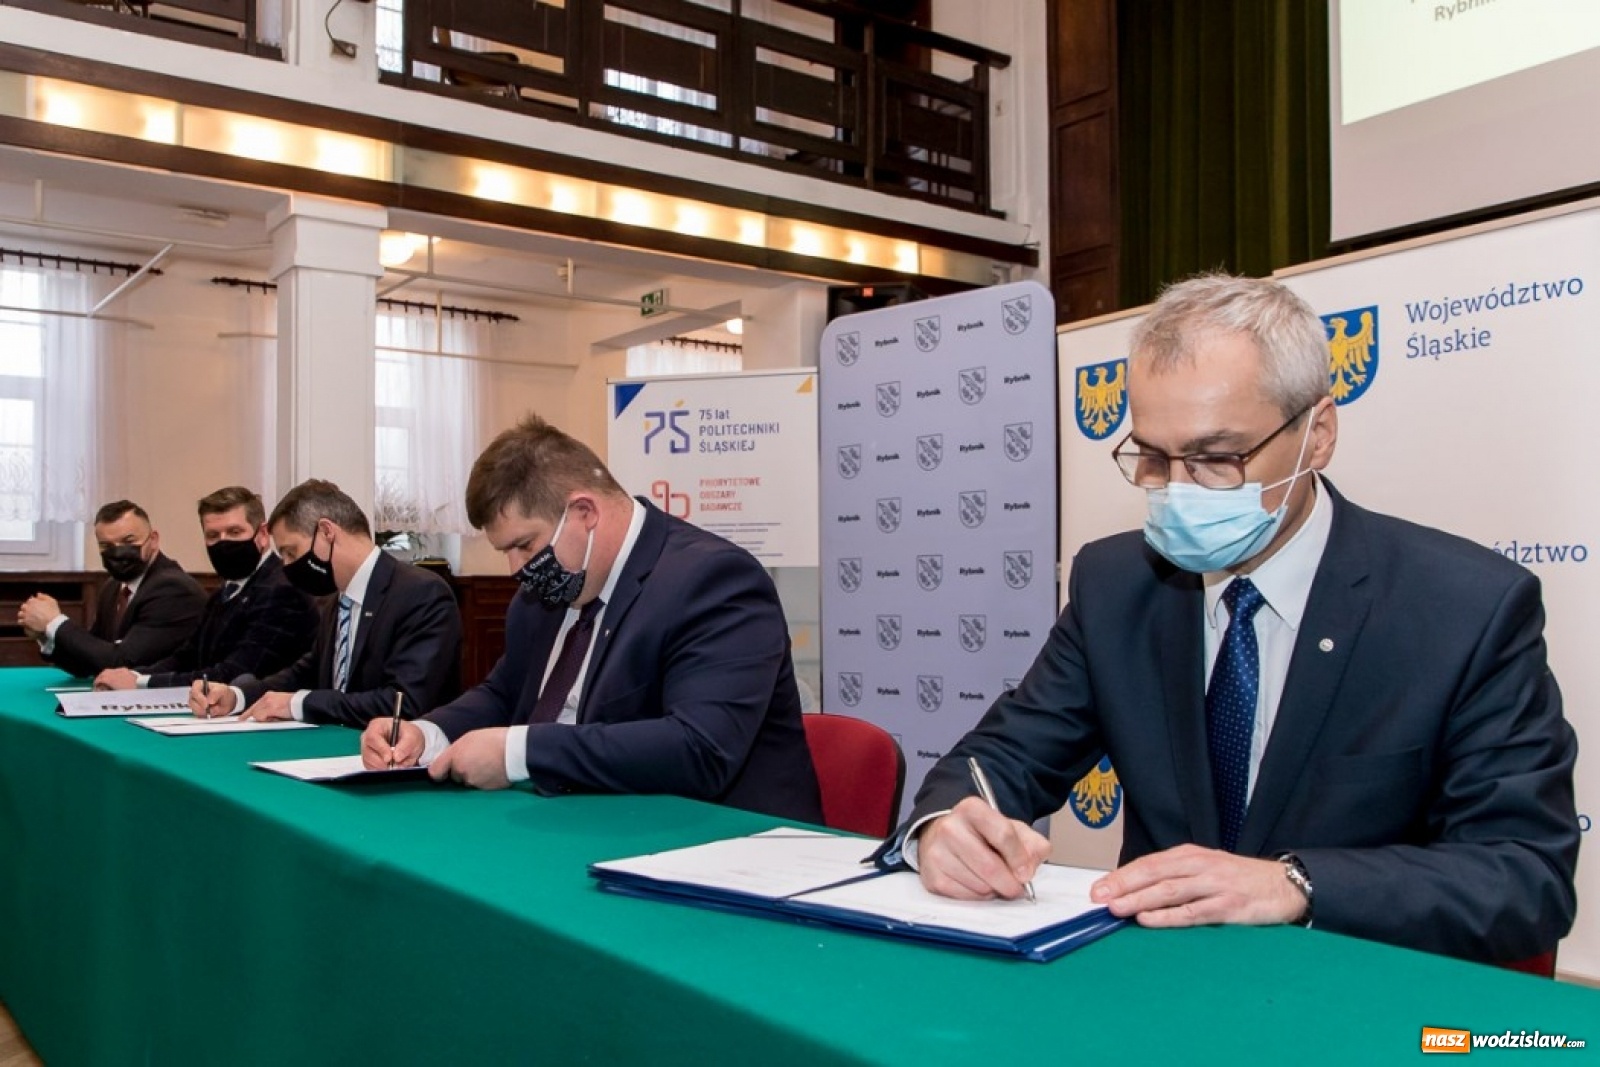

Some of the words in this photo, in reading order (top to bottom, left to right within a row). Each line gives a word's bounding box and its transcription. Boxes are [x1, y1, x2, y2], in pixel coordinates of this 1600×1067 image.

[1434, 0, 1498, 21] Rybn
[1405, 276, 1584, 325] Województwo
[957, 321, 985, 332] Rybnik
[875, 337, 899, 347] Rybnik
[1406, 327, 1491, 360] Śląskie
[1004, 373, 1031, 384] Rybnik
[916, 388, 941, 399] Rybnik
[838, 401, 861, 411] Rybnik
[699, 409, 712, 421] 75
[715, 409, 730, 420] lat
[699, 422, 780, 437] POLITECHNIKI
[699, 439, 755, 455] ŚLĄSKIEJ
[960, 442, 985, 453] Rybnik
[876, 453, 900, 463] Rybnik
[1004, 501, 1031, 511] Rybnik
[917, 508, 941, 517] Rybnik
[838, 514, 860, 523] Rybnik
[877, 569, 900, 578] Rybnik
[960, 566, 984, 576] Rybnik
[838, 627, 861, 636] Rybnik
[917, 628, 941, 637] Rybnik
[1004, 629, 1030, 638] Rybnik
[877, 686, 900, 696] Rybnik
[960, 691, 984, 701] Rybnik
